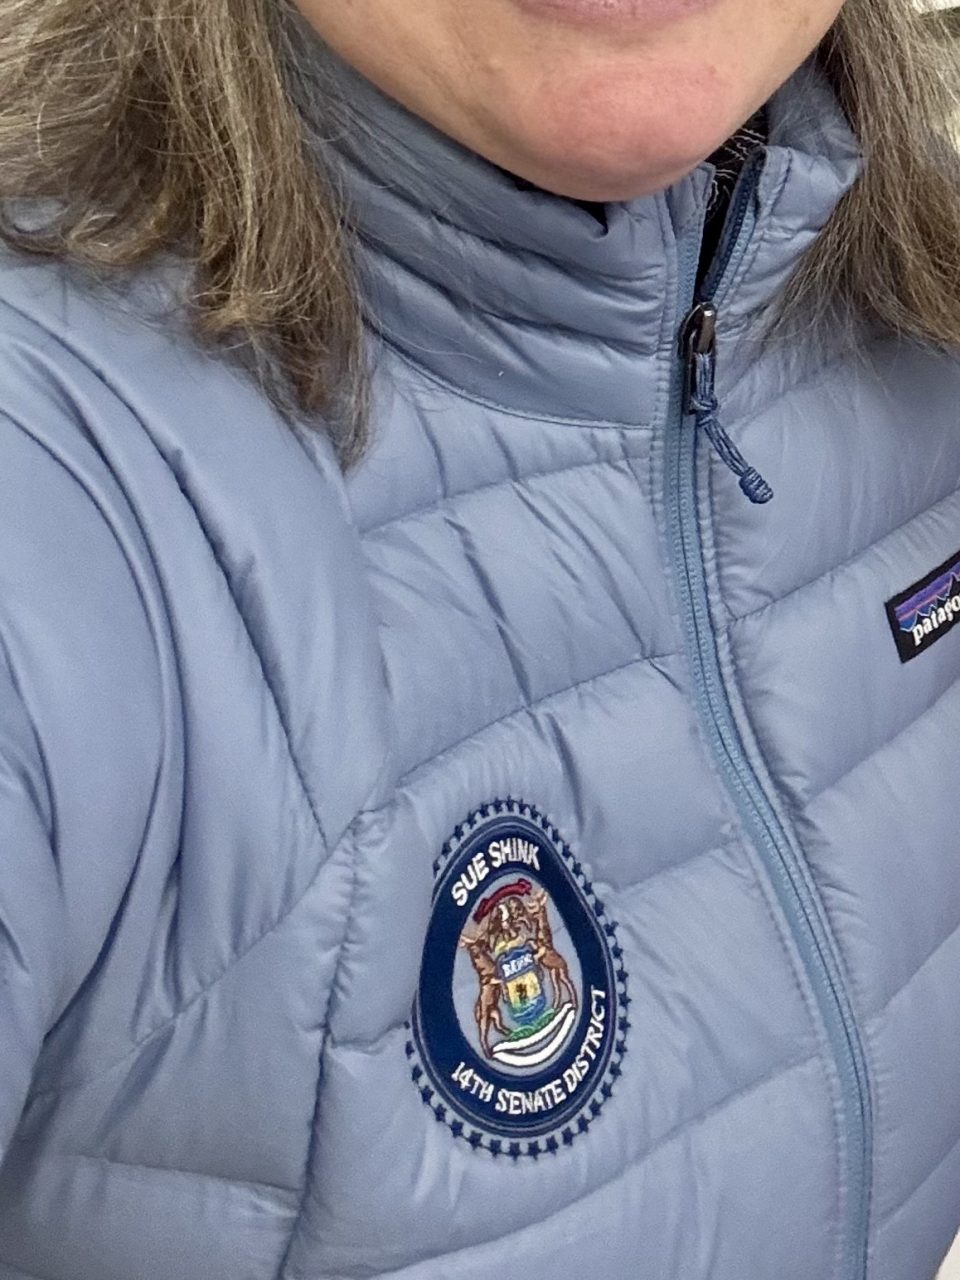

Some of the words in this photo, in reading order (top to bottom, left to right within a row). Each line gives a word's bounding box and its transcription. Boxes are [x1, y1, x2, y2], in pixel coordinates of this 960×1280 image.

[451, 852, 490, 907] SUE
[488, 837, 541, 871] SHINK
[451, 1061, 495, 1102] 14TH
[495, 1079, 567, 1115] SENATE
[562, 984, 606, 1093] DISTRICT
